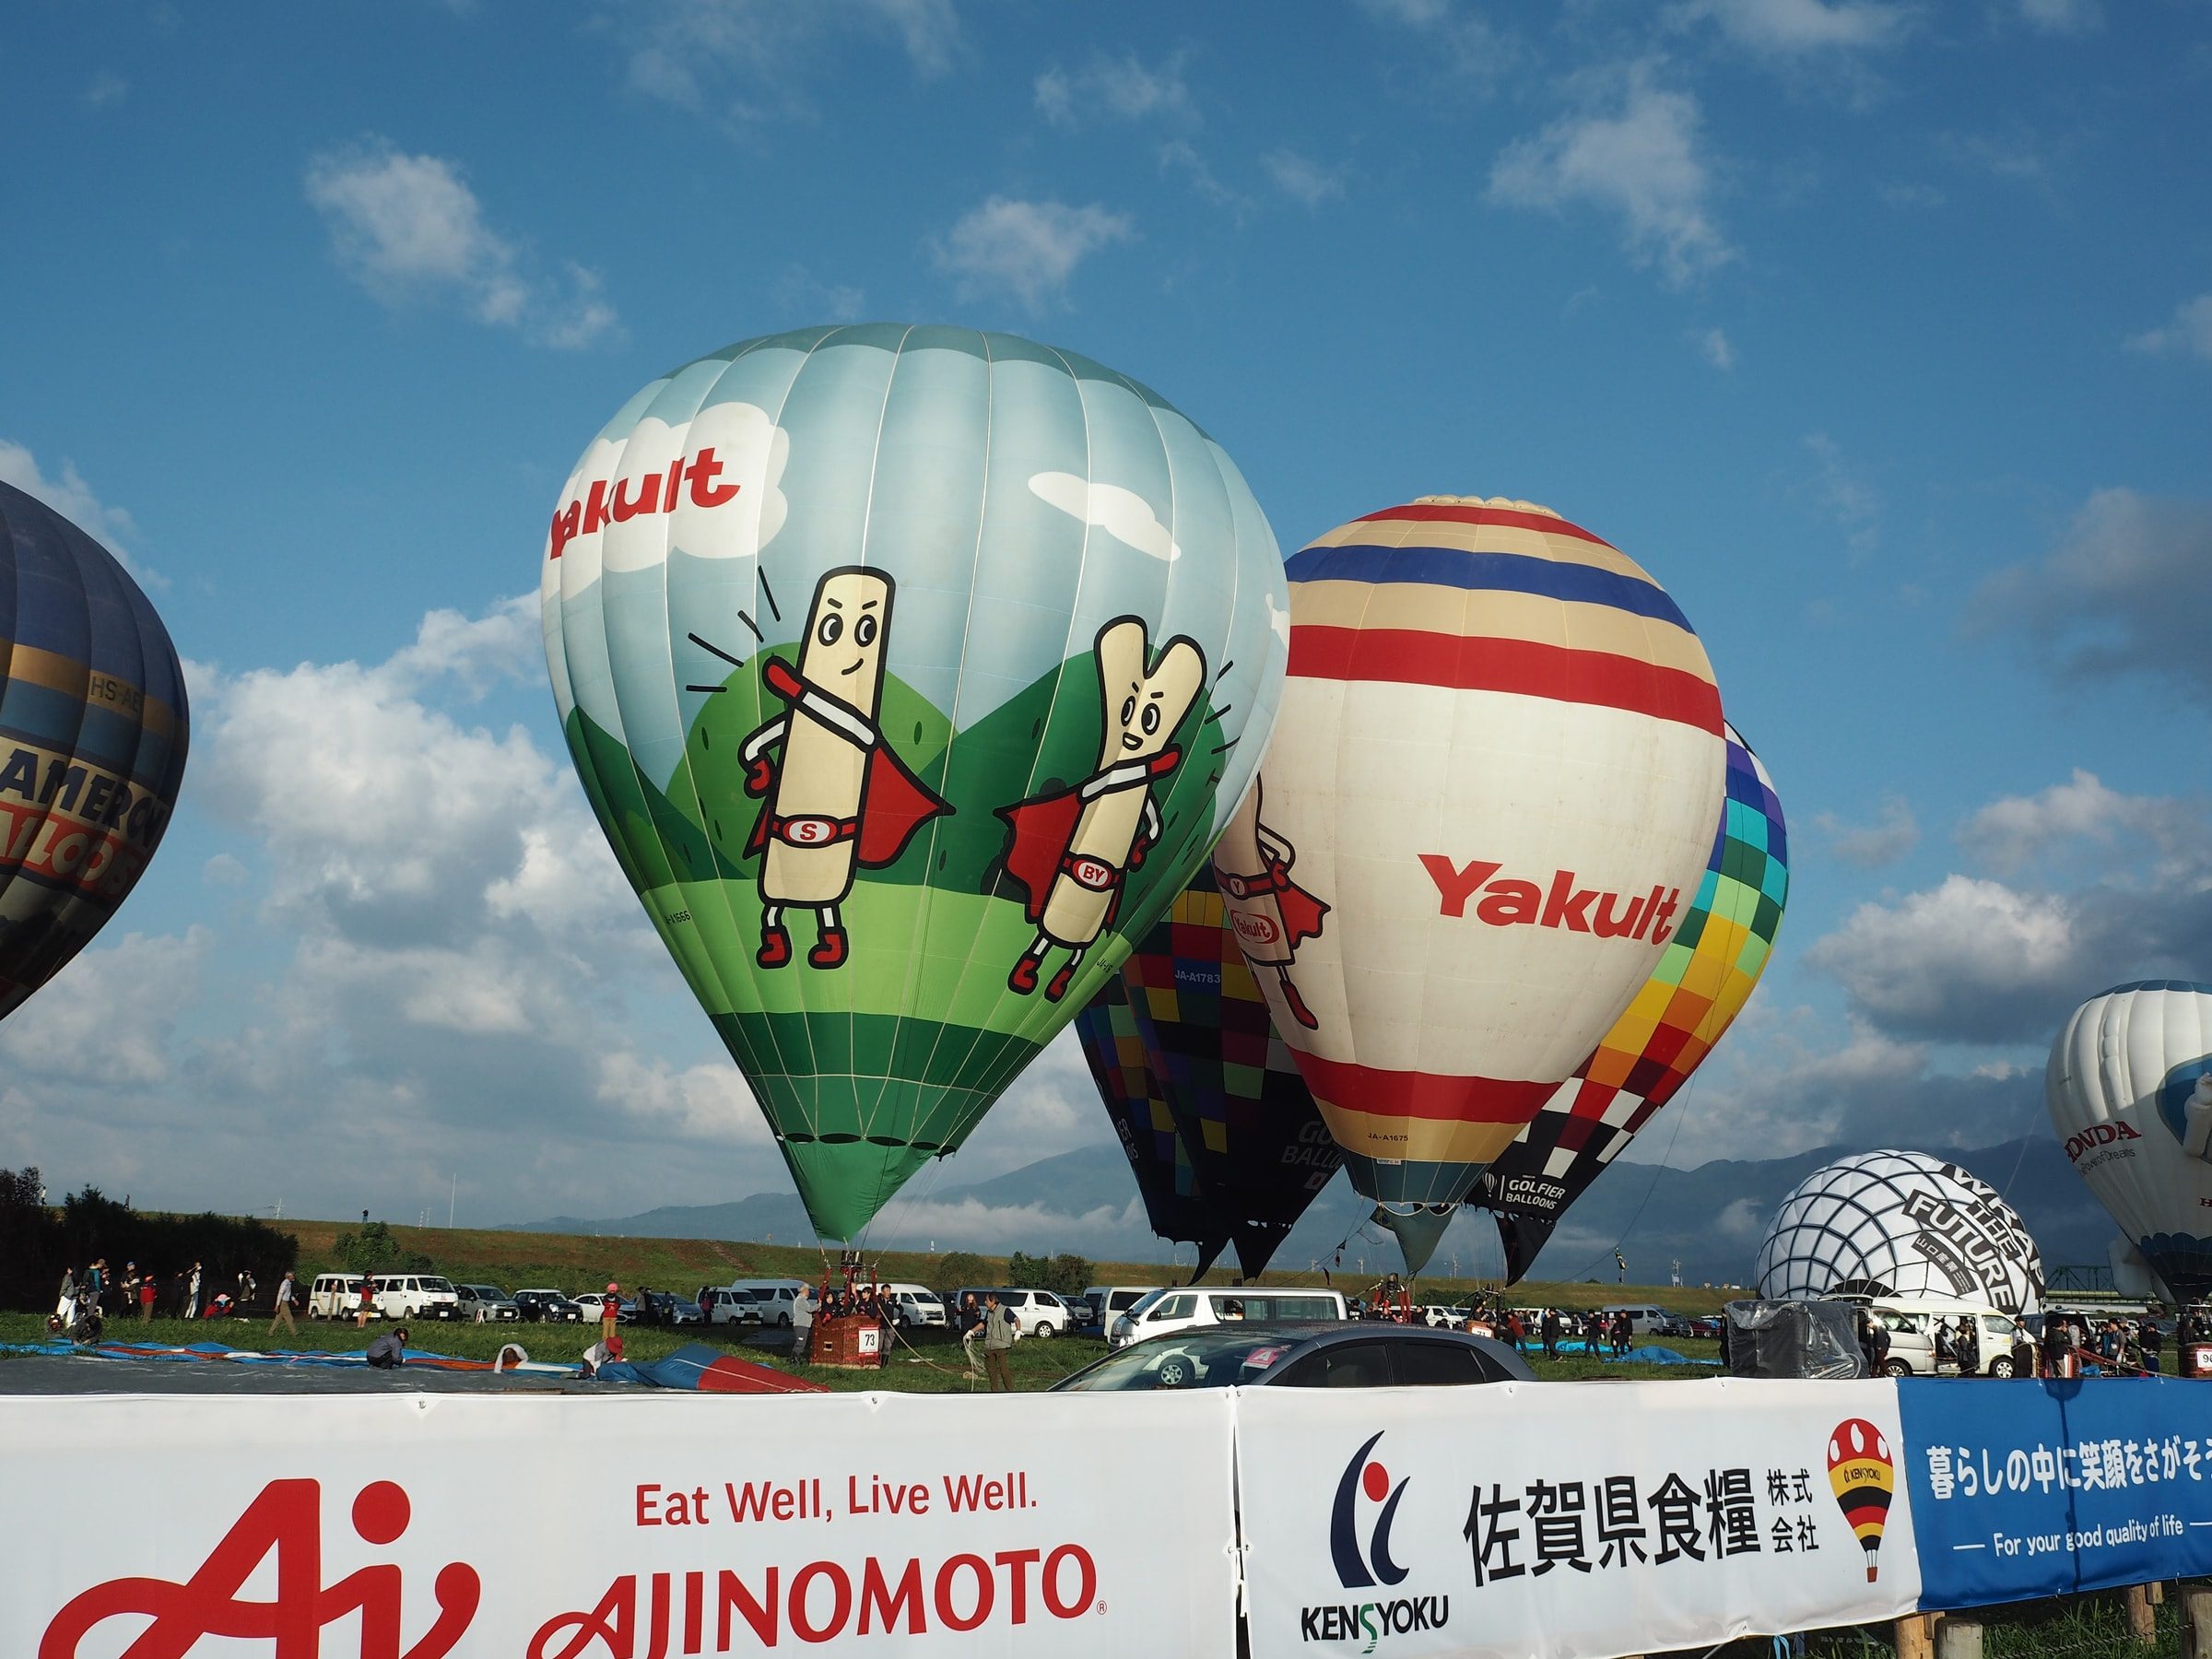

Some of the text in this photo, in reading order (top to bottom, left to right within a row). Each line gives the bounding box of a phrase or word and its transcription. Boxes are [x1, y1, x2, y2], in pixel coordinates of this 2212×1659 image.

[800, 823, 818, 841] S
[1083, 865, 1106, 883] BY
[1417, 853, 1680, 946] Yakult
[1234, 915, 1271, 938] Yakult
[1174, 969, 1221, 983] JA-A1783
[1367, 1132, 1409, 1142] JA-A1675
[1505, 1193, 1558, 1210] BALLOONS
[1509, 1179, 1566, 1199] GOLFIER
[1973, 1202, 2018, 1256] THE
[1909, 1194, 2015, 1309] FUTURE
[865, 1333, 876, 1347] 73
[636, 1472, 1038, 1526] Eat Well, Live Well.
[1766, 1468, 1813, 1505] 株式
[1463, 1468, 1761, 1587] 佐賀県食糧
[1771, 1514, 1819, 1553] 会社
[1993, 1513, 2183, 1558] For your good quality of life
[525, 1544, 1097, 1659] AJINOMOTO
[1300, 1594, 1449, 1654] KENSYOKU
